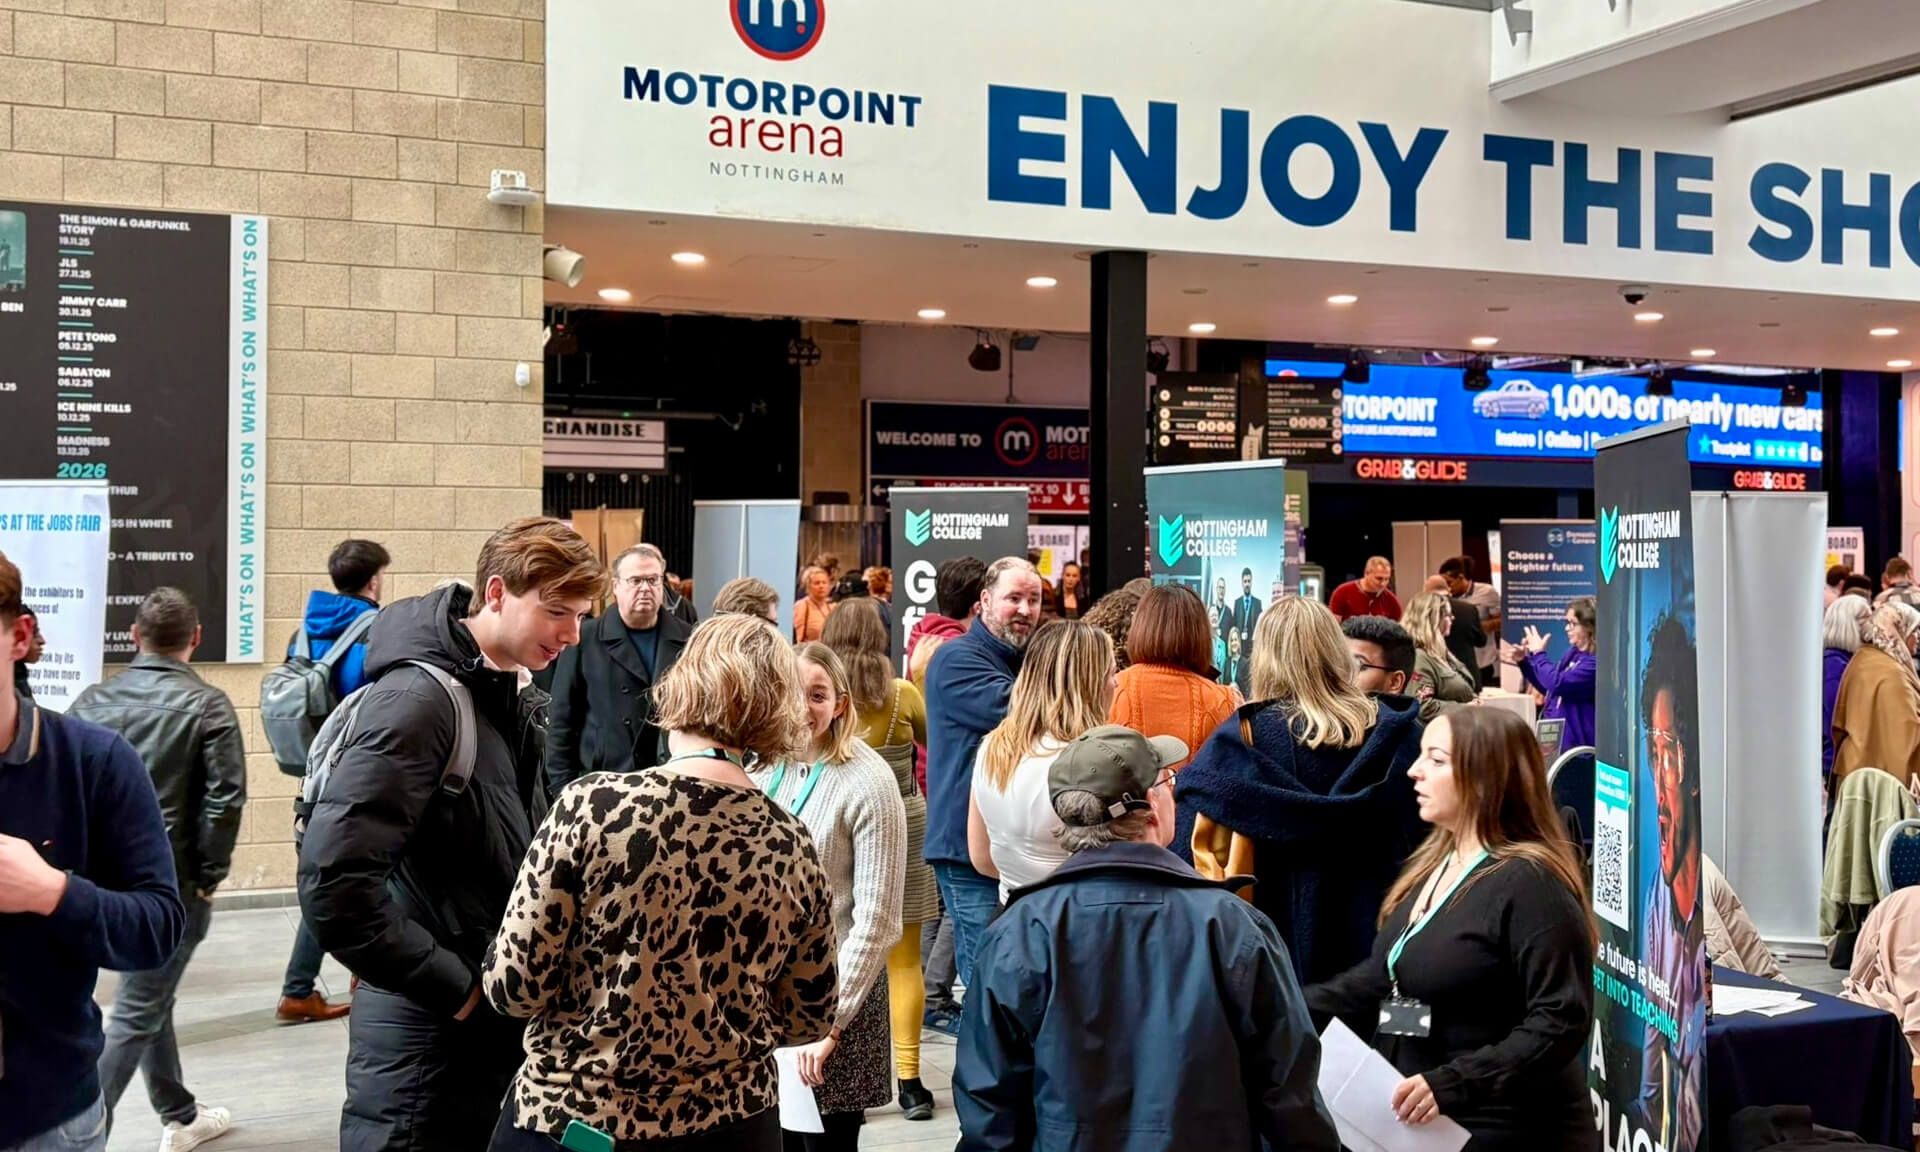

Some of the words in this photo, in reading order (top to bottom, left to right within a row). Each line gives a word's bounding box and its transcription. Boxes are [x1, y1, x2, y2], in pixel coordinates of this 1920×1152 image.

[624, 66, 922, 128] MOTORPOINT
[709, 115, 843, 158] arena
[710, 162, 844, 186] NOTTINGHAM
[988, 84, 1449, 233] ENJOY
[1483, 133, 1714, 256] THE
[1748, 162, 1920, 269] SH
[59, 214, 80, 224] THE
[82, 215, 118, 226] SIMON
[120, 218, 128, 227] &
[129, 218, 191, 232] GARFUNKEL
[59, 224, 96, 236] STORY
[244, 220, 257, 246] ON
[59, 258, 78, 268] JLS
[59, 268, 92, 279] 27.11.25
[242, 251, 256, 322] WHAT'S
[58, 296, 95, 307] JIMMY
[96, 298, 128, 308] CARR
[58, 307, 92, 318] 30.11.25
[58, 331, 84, 342] PETE
[86, 332, 117, 342] TONG
[242, 332, 256, 358] ON
[58, 366, 111, 378] SABATON
[241, 361, 256, 434] WHAT'S
[57, 402, 76, 412] ICE
[77, 402, 102, 412] NINE
[104, 403, 132, 413] KILLS
[1342, 394, 1438, 422] TORPOINT
[1551, 383, 1632, 421] 1,000s
[1662, 392, 1734, 432] nearly
[1736, 406, 1782, 429] new
[544, 420, 646, 438] CHANDISE
[57, 436, 111, 447] MADNESS
[877, 431, 957, 447] WELCOME
[960, 433, 982, 447] TO
[241, 443, 255, 470] ON
[56, 462, 107, 478] 2026
[1356, 458, 1468, 481] GRAB&GLIDE
[110, 486, 138, 496] THUR
[240, 473, 255, 545] WHAT'S
[10, 514, 23, 530] AT
[26, 514, 44, 531] THE
[47, 514, 72, 531] JOBS
[75, 515, 101, 532] FAIR
[126, 518, 138, 529] IN
[139, 518, 173, 529] WHITE
[932, 513, 1009, 528] NOTTINGHAM
[1186, 519, 1268, 538] NOTTINGHAM
[1618, 510, 1680, 540] NOTTINGHAM
[932, 526, 983, 540] COLLEGE
[126, 552, 135, 561] A
[136, 552, 178, 561] TRIBUTE
[179, 552, 194, 561] TO
[1186, 539, 1238, 556] COLLEGE
[1508, 550, 1546, 560] Choose
[1547, 552, 1554, 560] a
[1617, 542, 1660, 569] COLLEGE
[240, 554, 254, 580] ON
[1508, 562, 1550, 574] brighter
[1552, 562, 1584, 572] future
[904, 560, 938, 604] G
[239, 584, 254, 656] WHAT'S
[1598, 940, 1605, 960] e
[1607, 942, 1636, 980] future
[1638, 960, 1647, 986] is
[1606, 974, 1629, 1008] INTO
[1630, 989, 1679, 1044] TEACHING
[1590, 1018, 1606, 1082] A
